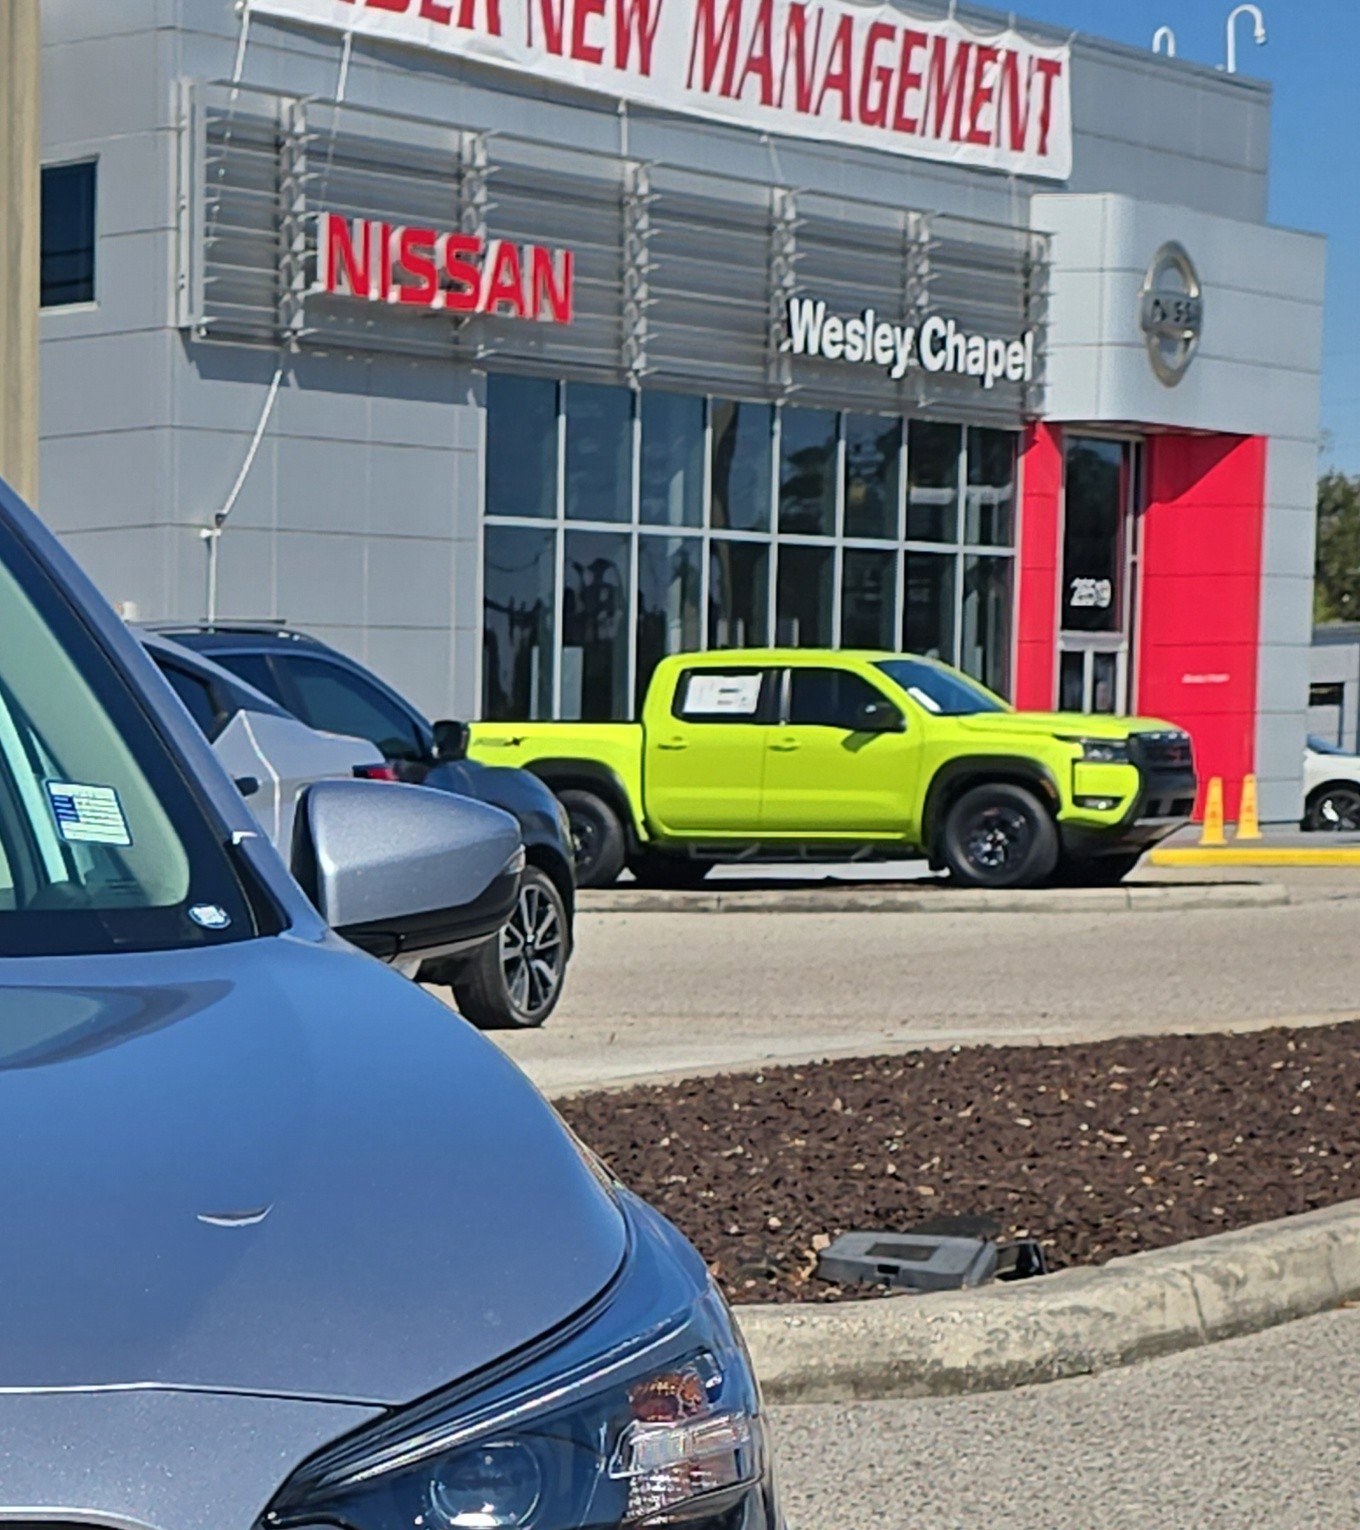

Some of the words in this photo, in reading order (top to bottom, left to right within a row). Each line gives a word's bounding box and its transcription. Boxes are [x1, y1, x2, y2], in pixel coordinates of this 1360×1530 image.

[686, 0, 1063, 156] MANAGEMENT
[322, 212, 574, 325] NISSAN
[788, 297, 915, 379] Wesley
[919, 315, 1034, 390] Chapel
